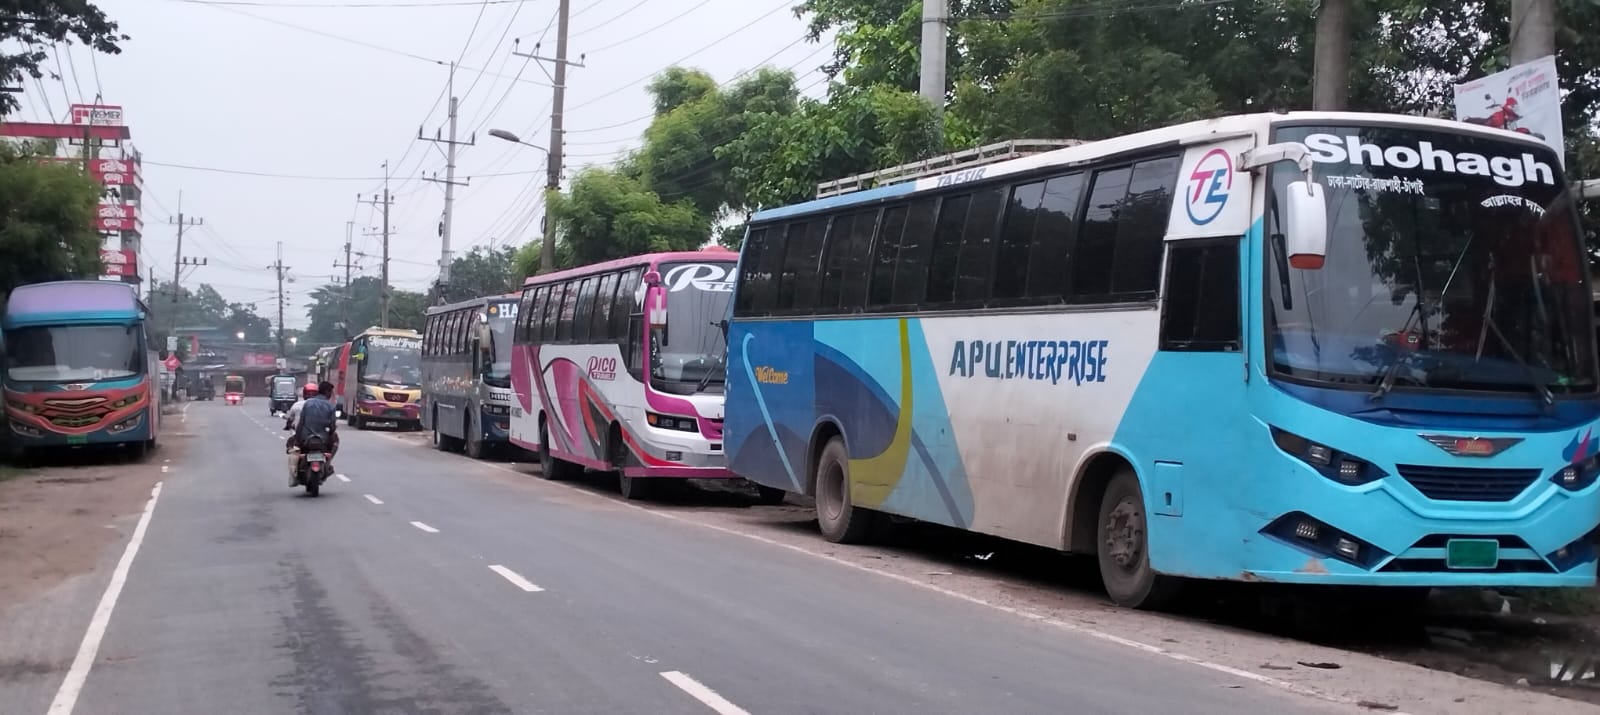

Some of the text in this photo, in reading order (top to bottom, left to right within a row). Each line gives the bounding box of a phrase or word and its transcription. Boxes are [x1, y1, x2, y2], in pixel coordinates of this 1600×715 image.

[1304, 133, 1555, 187] Shohagh
[1190, 168, 1229, 204] TE
[1480, 194, 1546, 217] আল্লাহর দান
[586, 356, 616, 379] RICO
